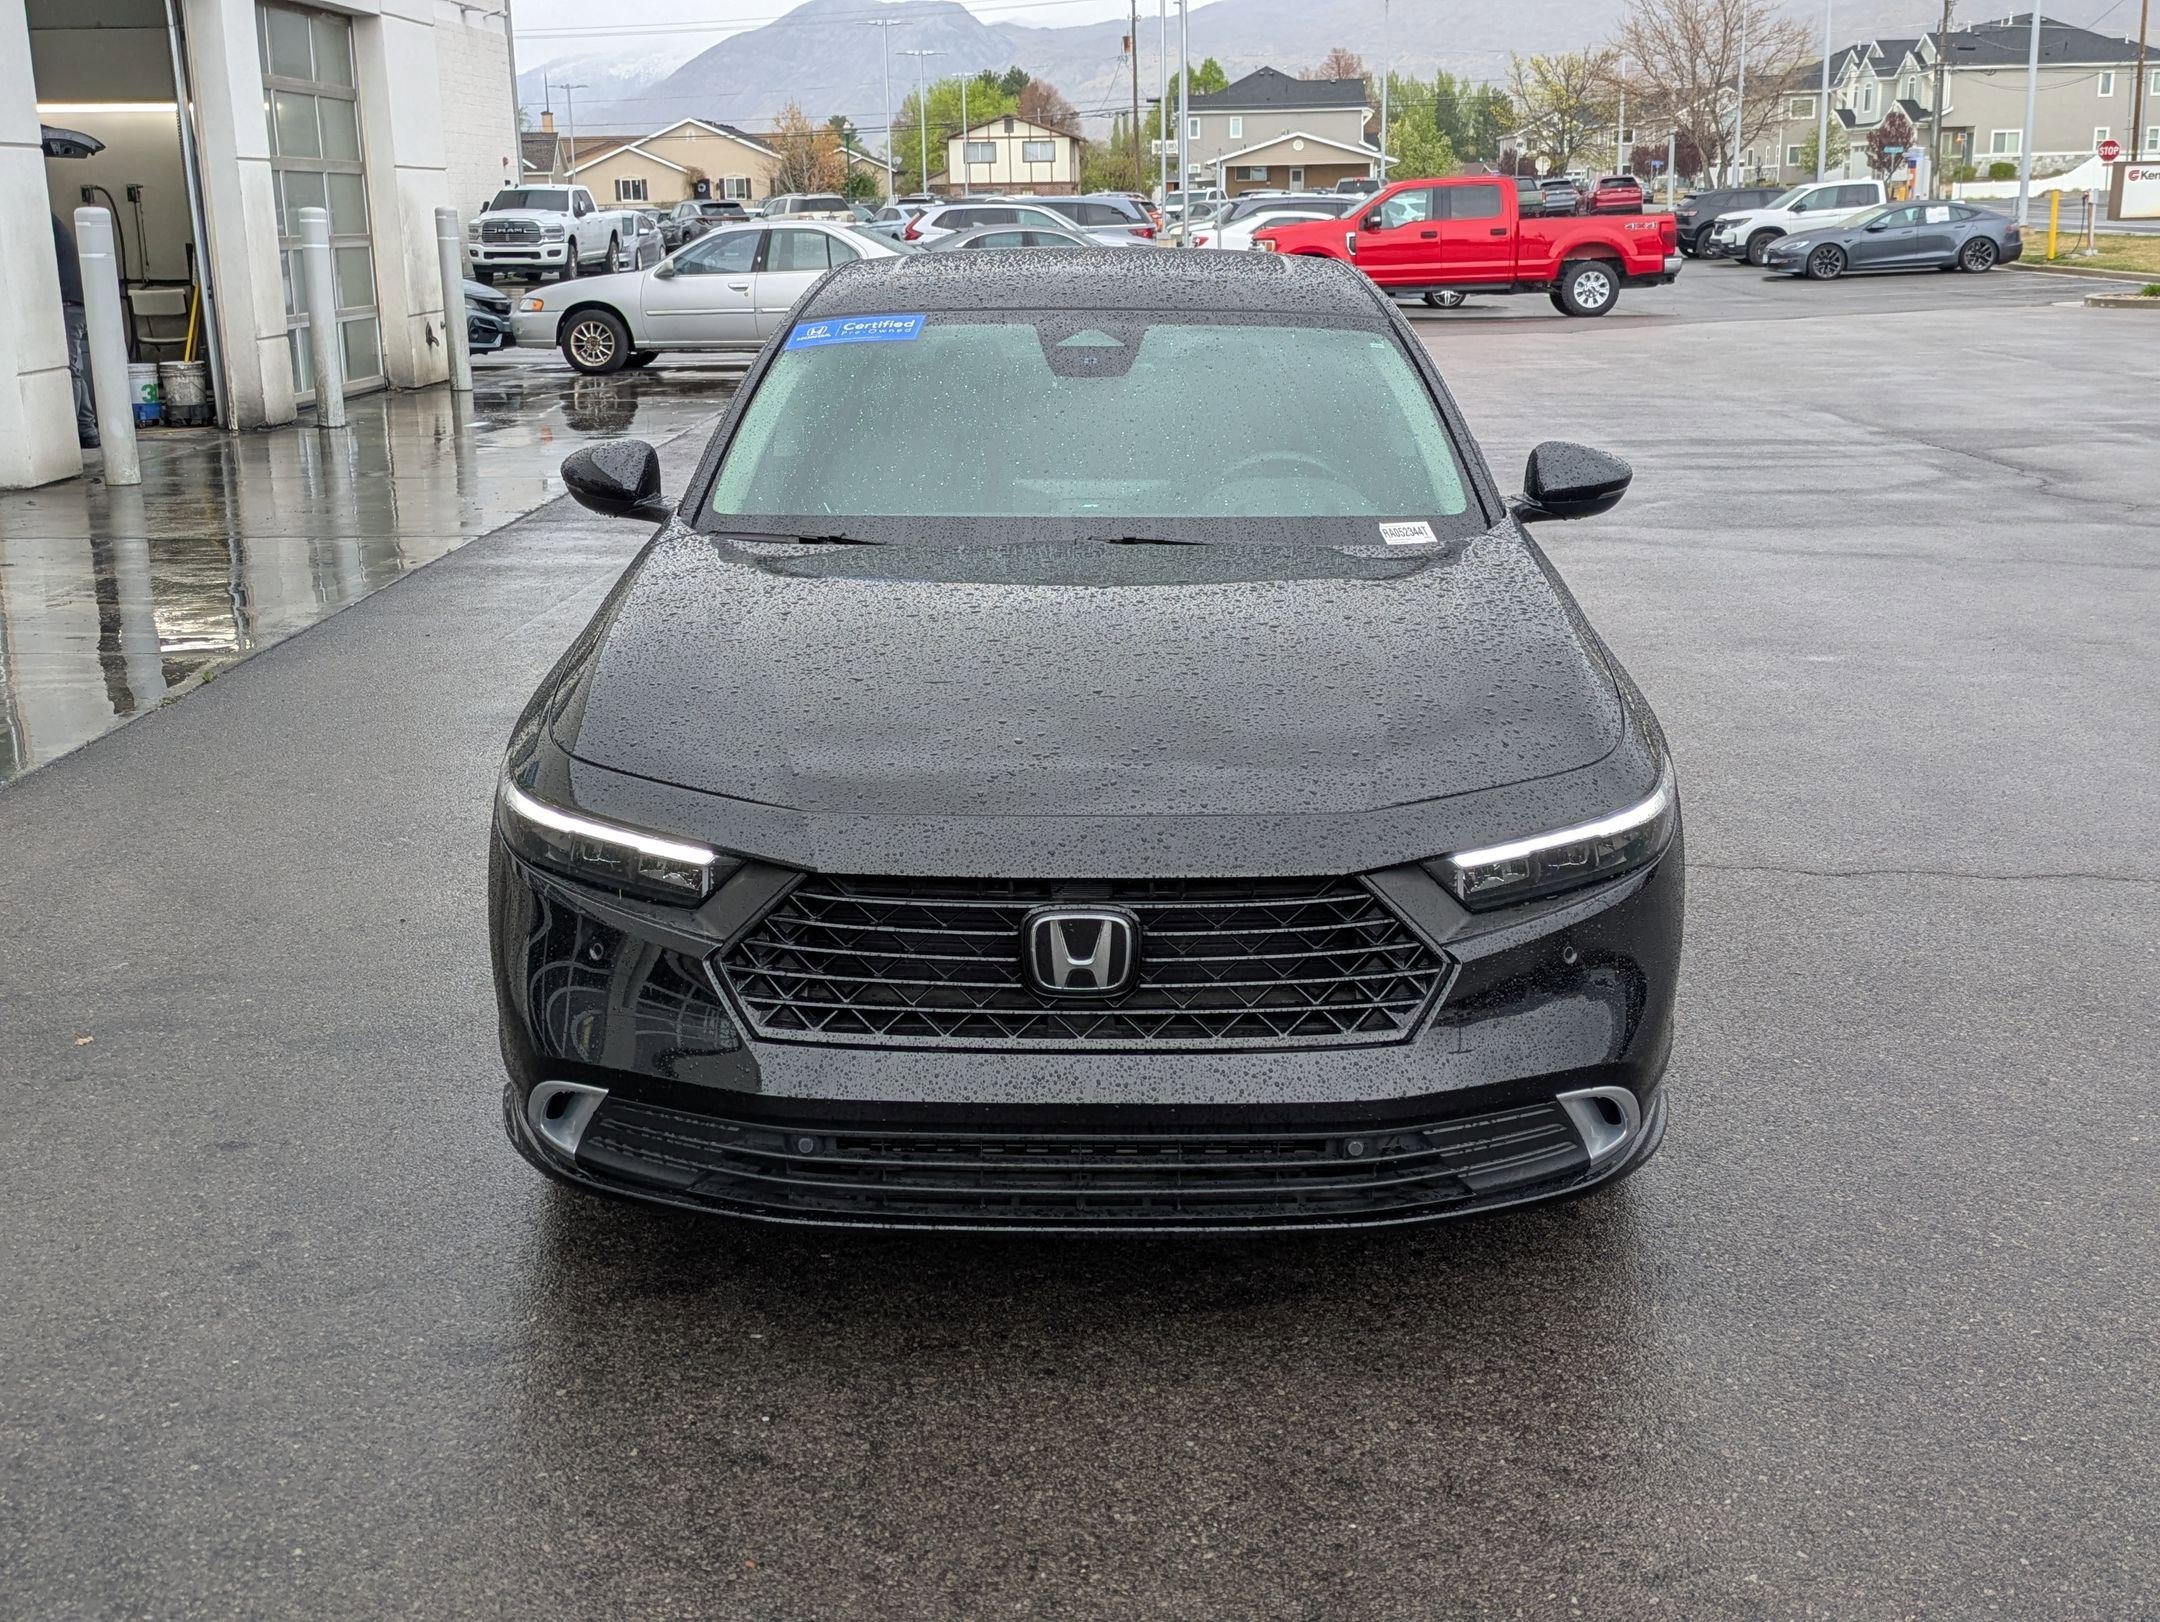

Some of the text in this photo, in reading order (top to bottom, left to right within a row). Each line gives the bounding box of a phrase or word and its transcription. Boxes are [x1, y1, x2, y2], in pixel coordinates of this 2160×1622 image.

[2098, 146, 2120, 156] STOP
[843, 319, 916, 331] Certified
[841, 327, 912, 336] Pre-Owned
